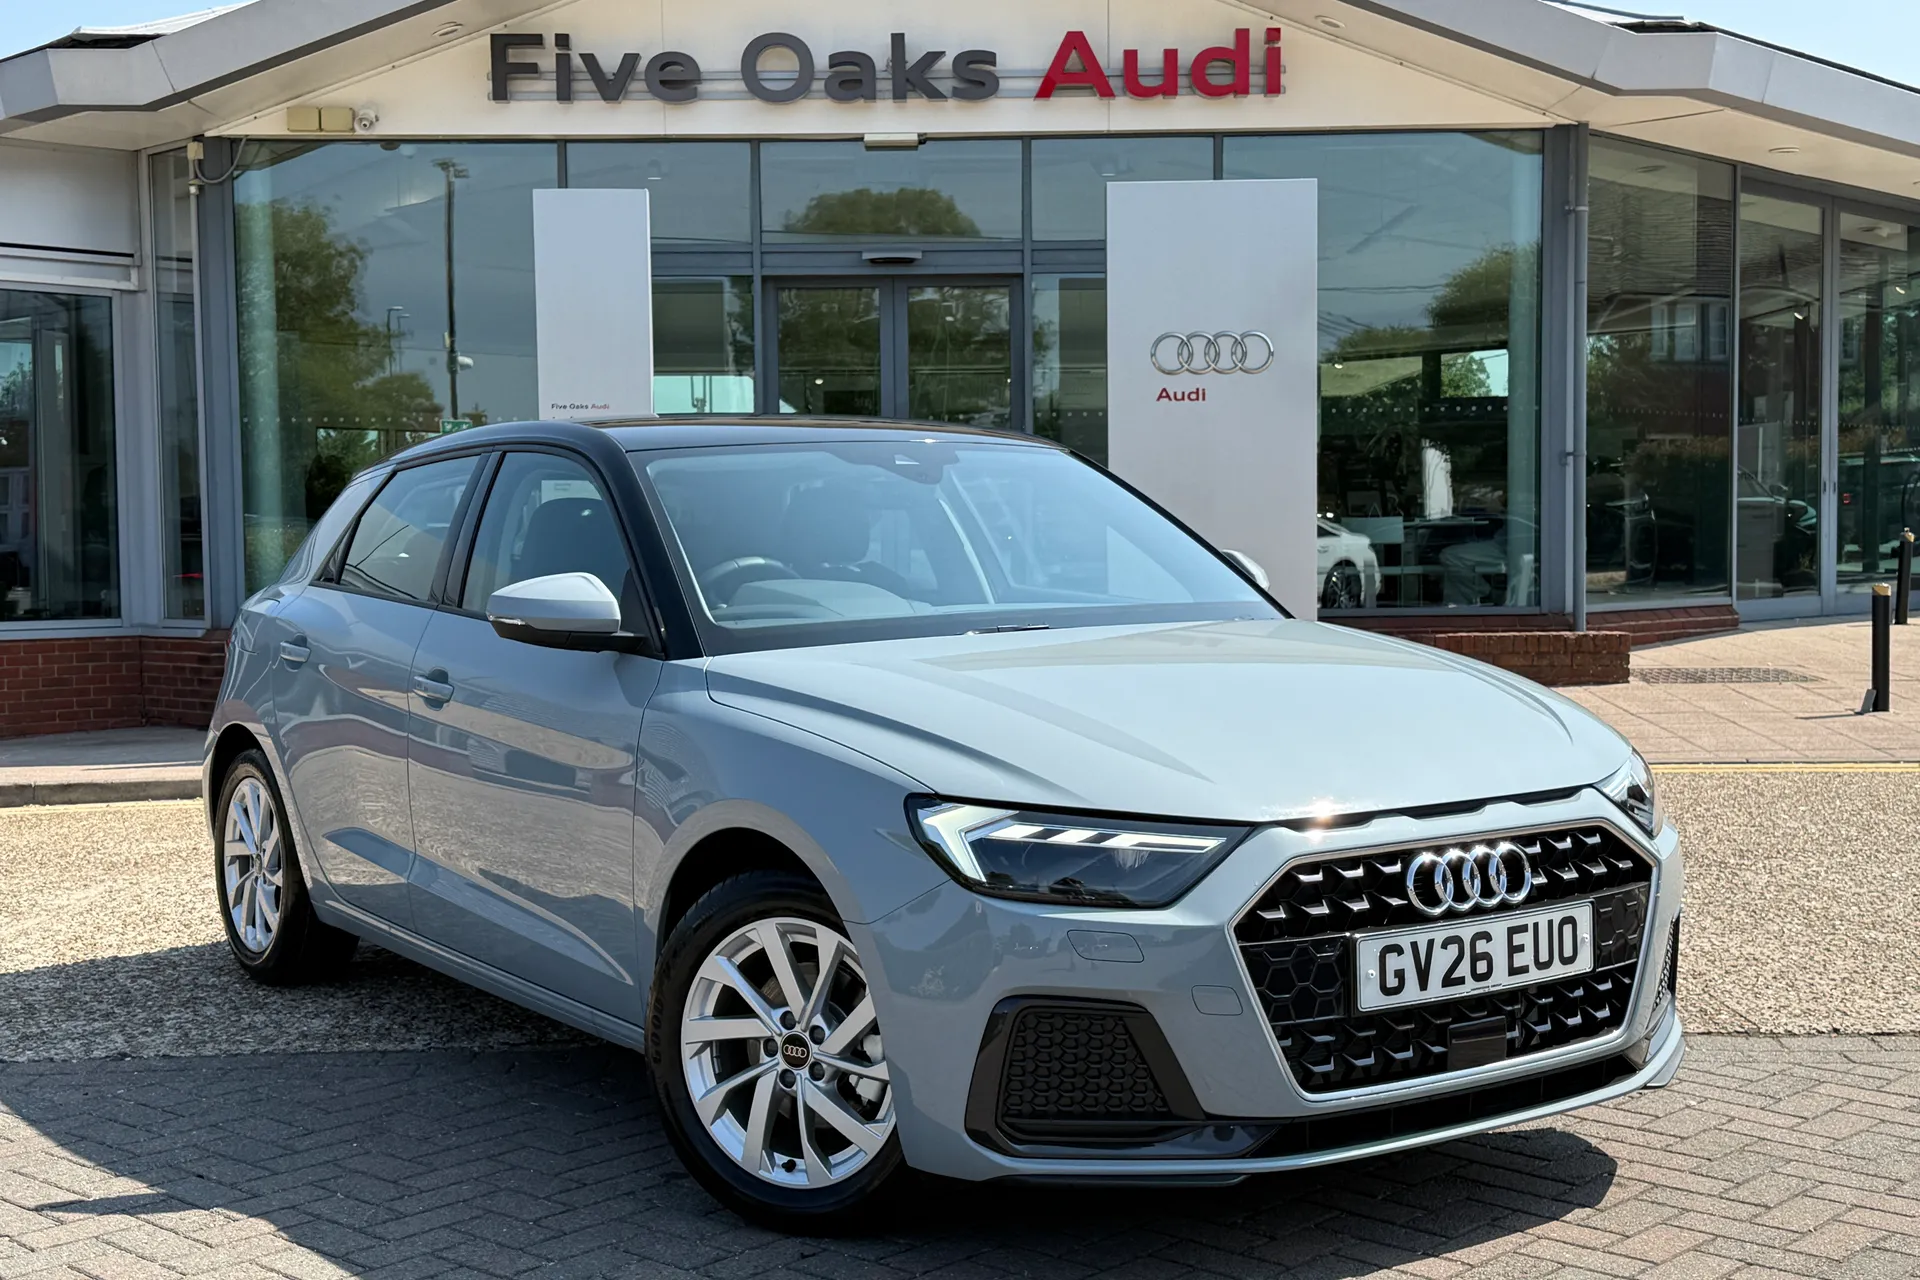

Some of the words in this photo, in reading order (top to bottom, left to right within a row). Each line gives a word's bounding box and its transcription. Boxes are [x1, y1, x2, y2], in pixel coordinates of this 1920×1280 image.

[490, 33, 701, 104] Five
[741, 32, 999, 104] Oaks
[1034, 27, 1281, 100] Audi
[1156, 387, 1206, 402] Audi
[1378, 930, 1494, 997] GV26
[1506, 915, 1579, 977] EUO
